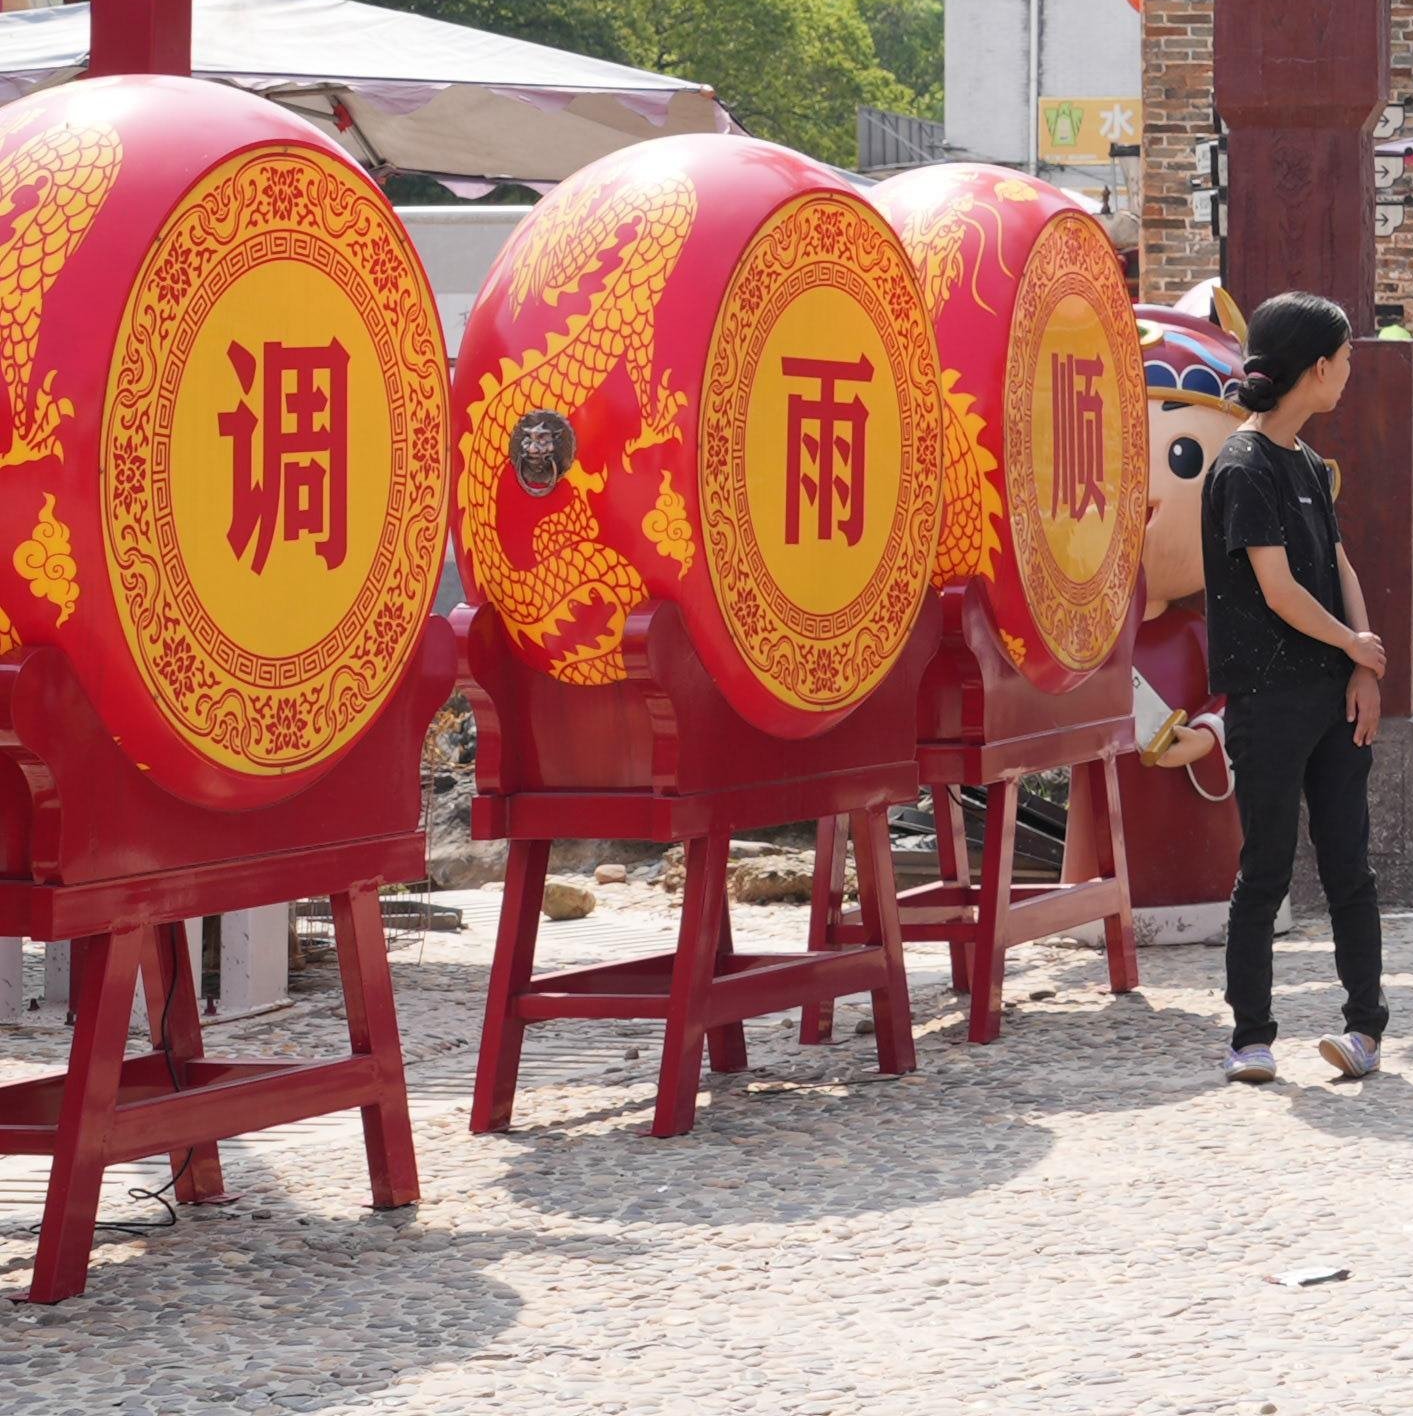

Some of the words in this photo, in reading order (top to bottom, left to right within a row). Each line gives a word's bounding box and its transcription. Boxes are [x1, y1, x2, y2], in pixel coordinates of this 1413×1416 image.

[1099, 102, 1135, 140] 水
[217, 336, 351, 576] 调
[781, 352, 875, 547] 雨
[1051, 352, 1106, 523] 顺
